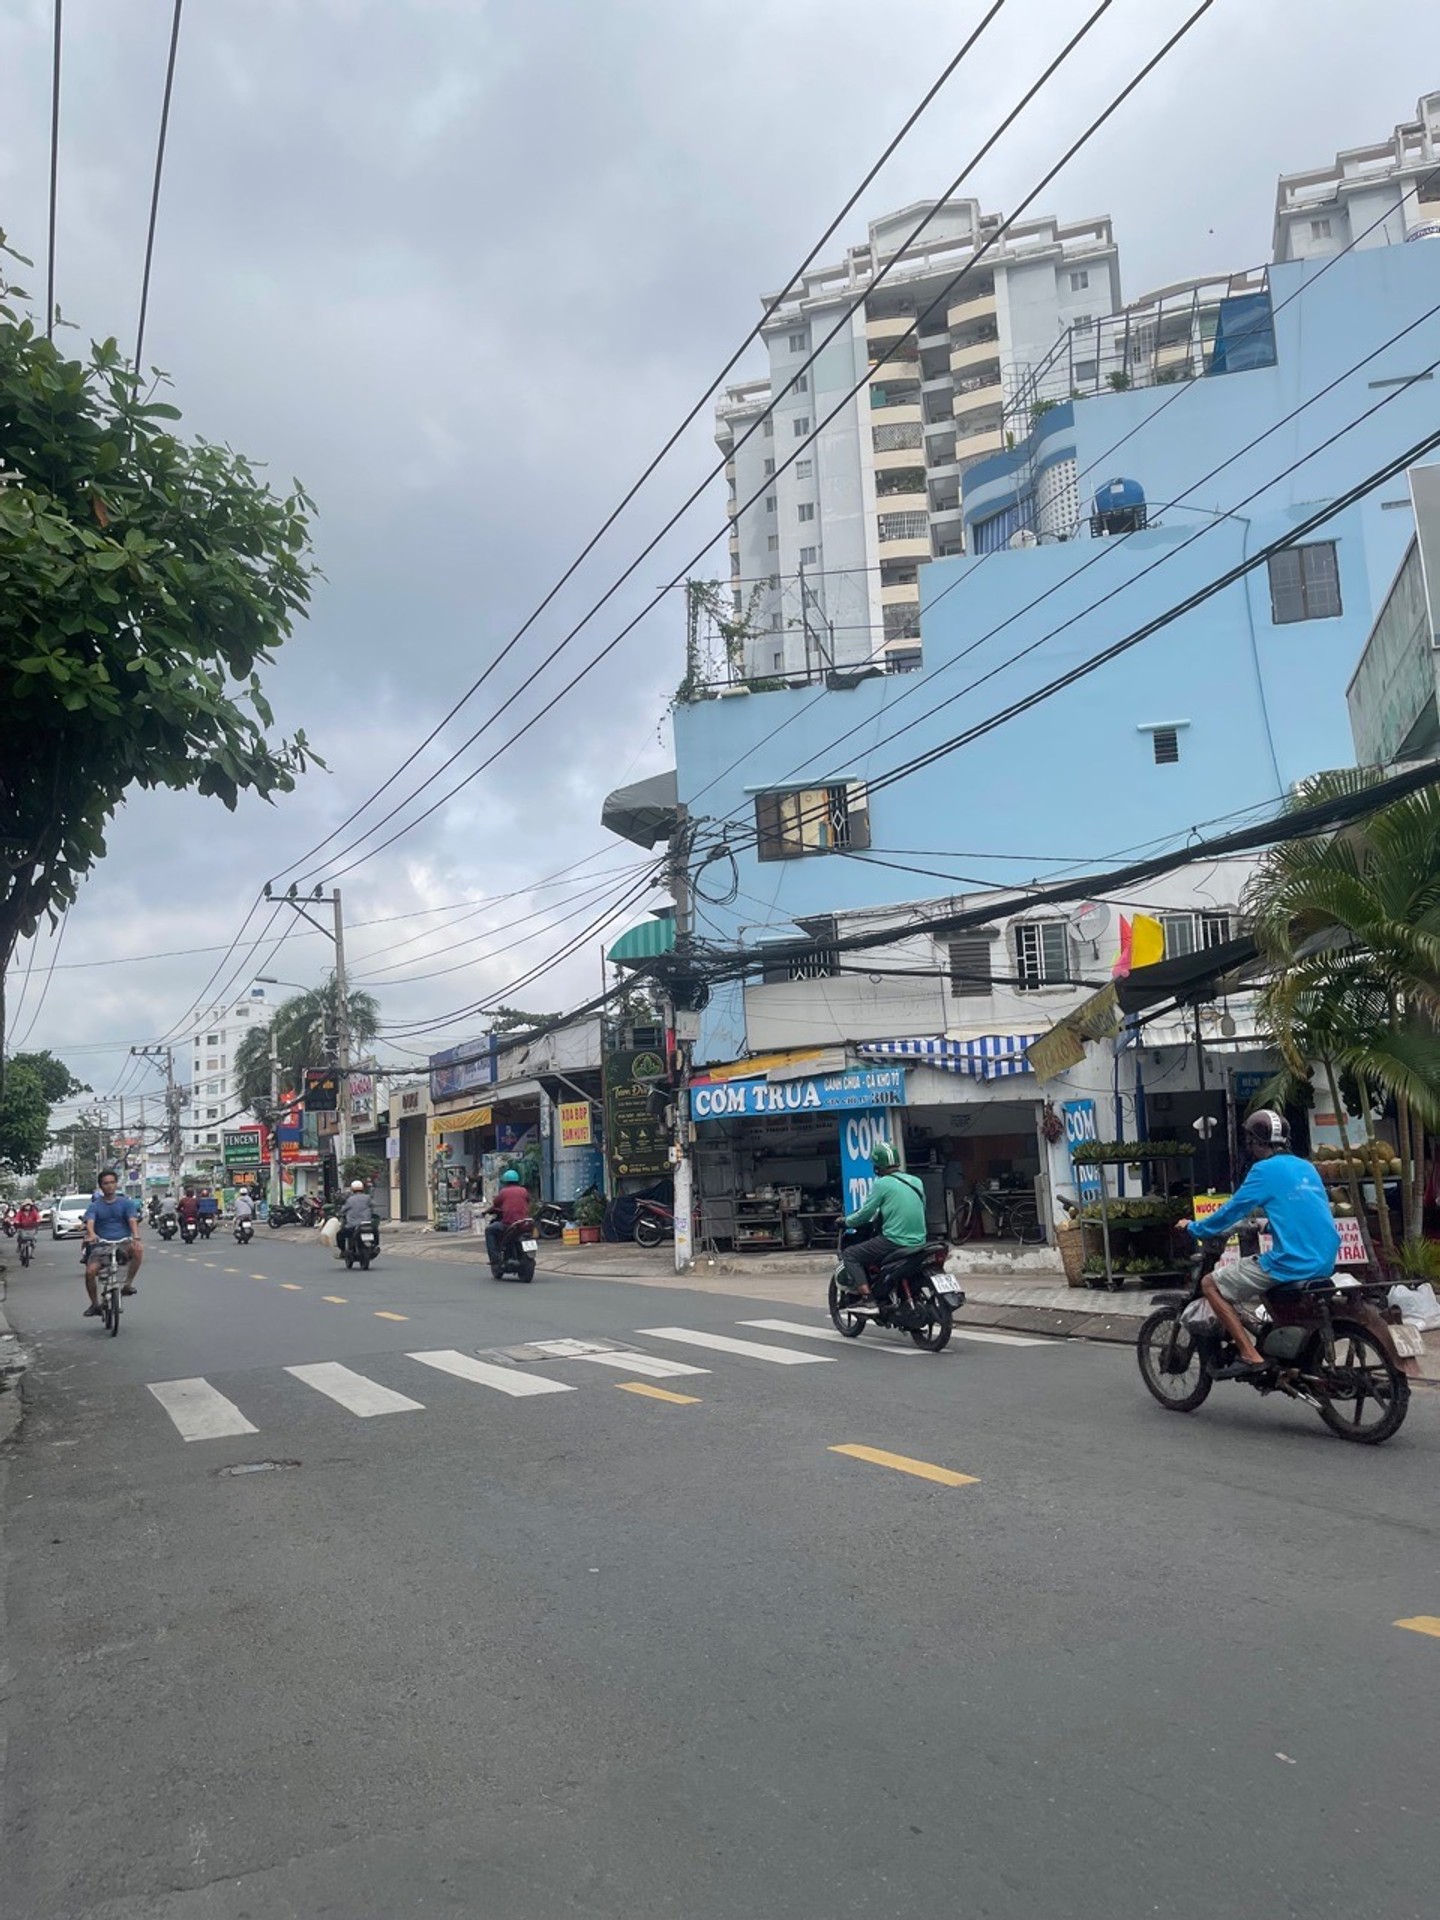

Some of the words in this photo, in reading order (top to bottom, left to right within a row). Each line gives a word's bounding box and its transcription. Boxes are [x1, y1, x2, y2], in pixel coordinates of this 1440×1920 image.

[696, 1084, 746, 1116] CƠM
[752, 1080, 821, 1112] TRƯA
[871, 1090, 900, 1104] 30K
[847, 1110, 885, 1160] CƠM
[1065, 1104, 1096, 1142] CƠM
